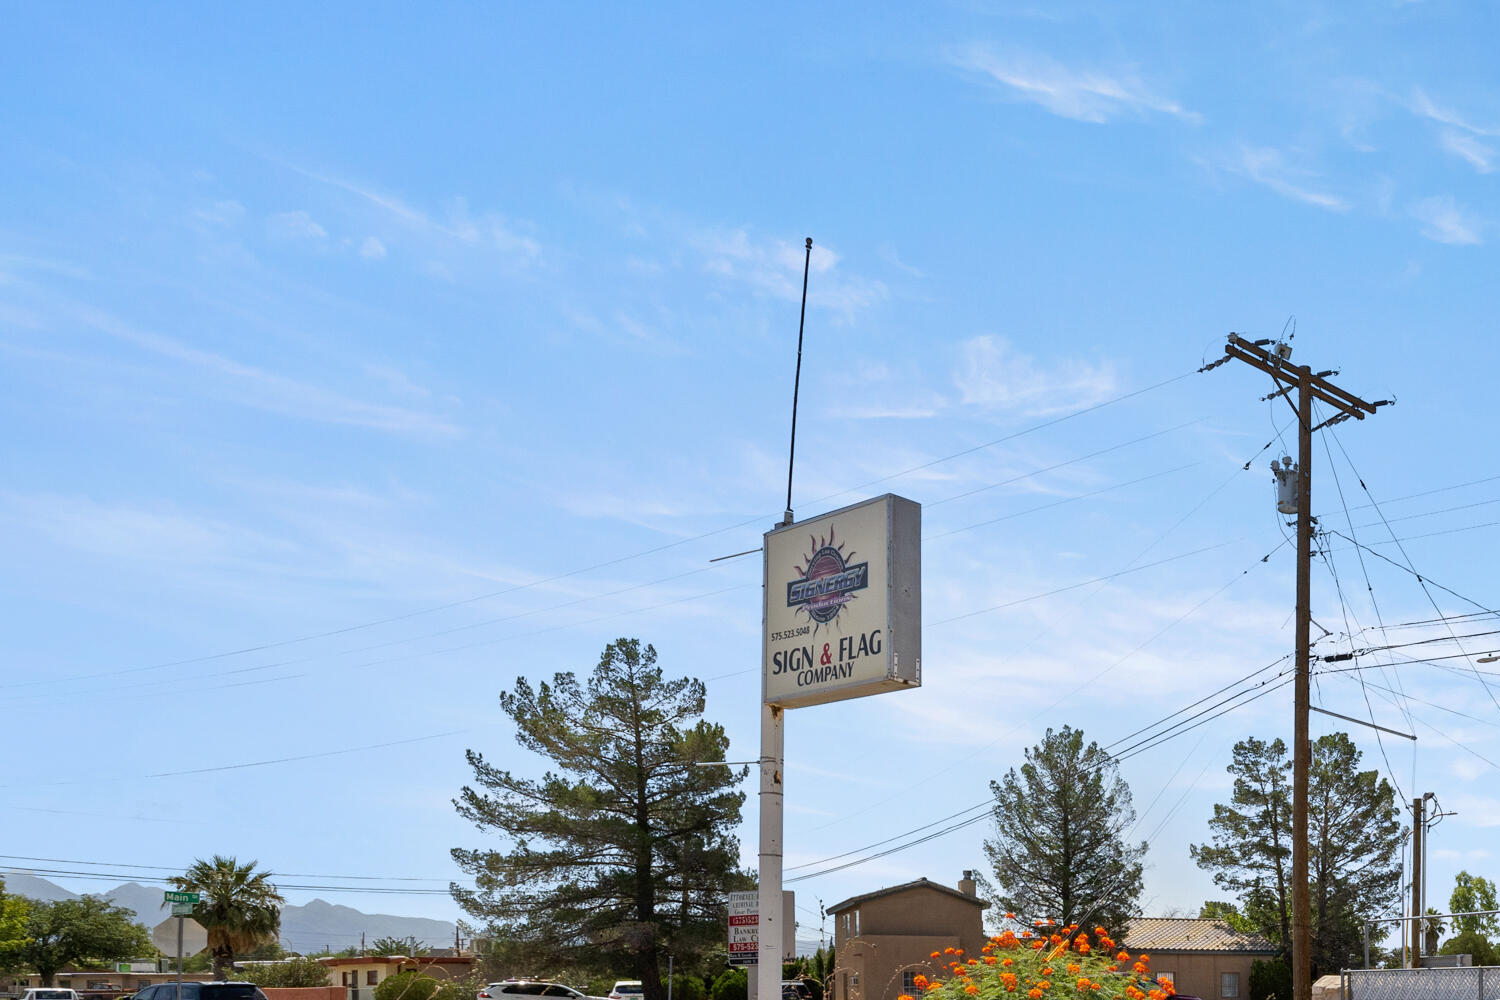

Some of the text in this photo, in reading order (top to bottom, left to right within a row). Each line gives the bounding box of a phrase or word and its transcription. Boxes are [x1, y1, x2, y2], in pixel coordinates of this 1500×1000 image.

[789, 566, 866, 602] SIGNERGY
[771, 626, 810, 641] 575.523.5048
[772, 629, 881, 675] SIGN & FLAG
[797, 661, 854, 687] COMPANY
[166, 892, 189, 902] Main
